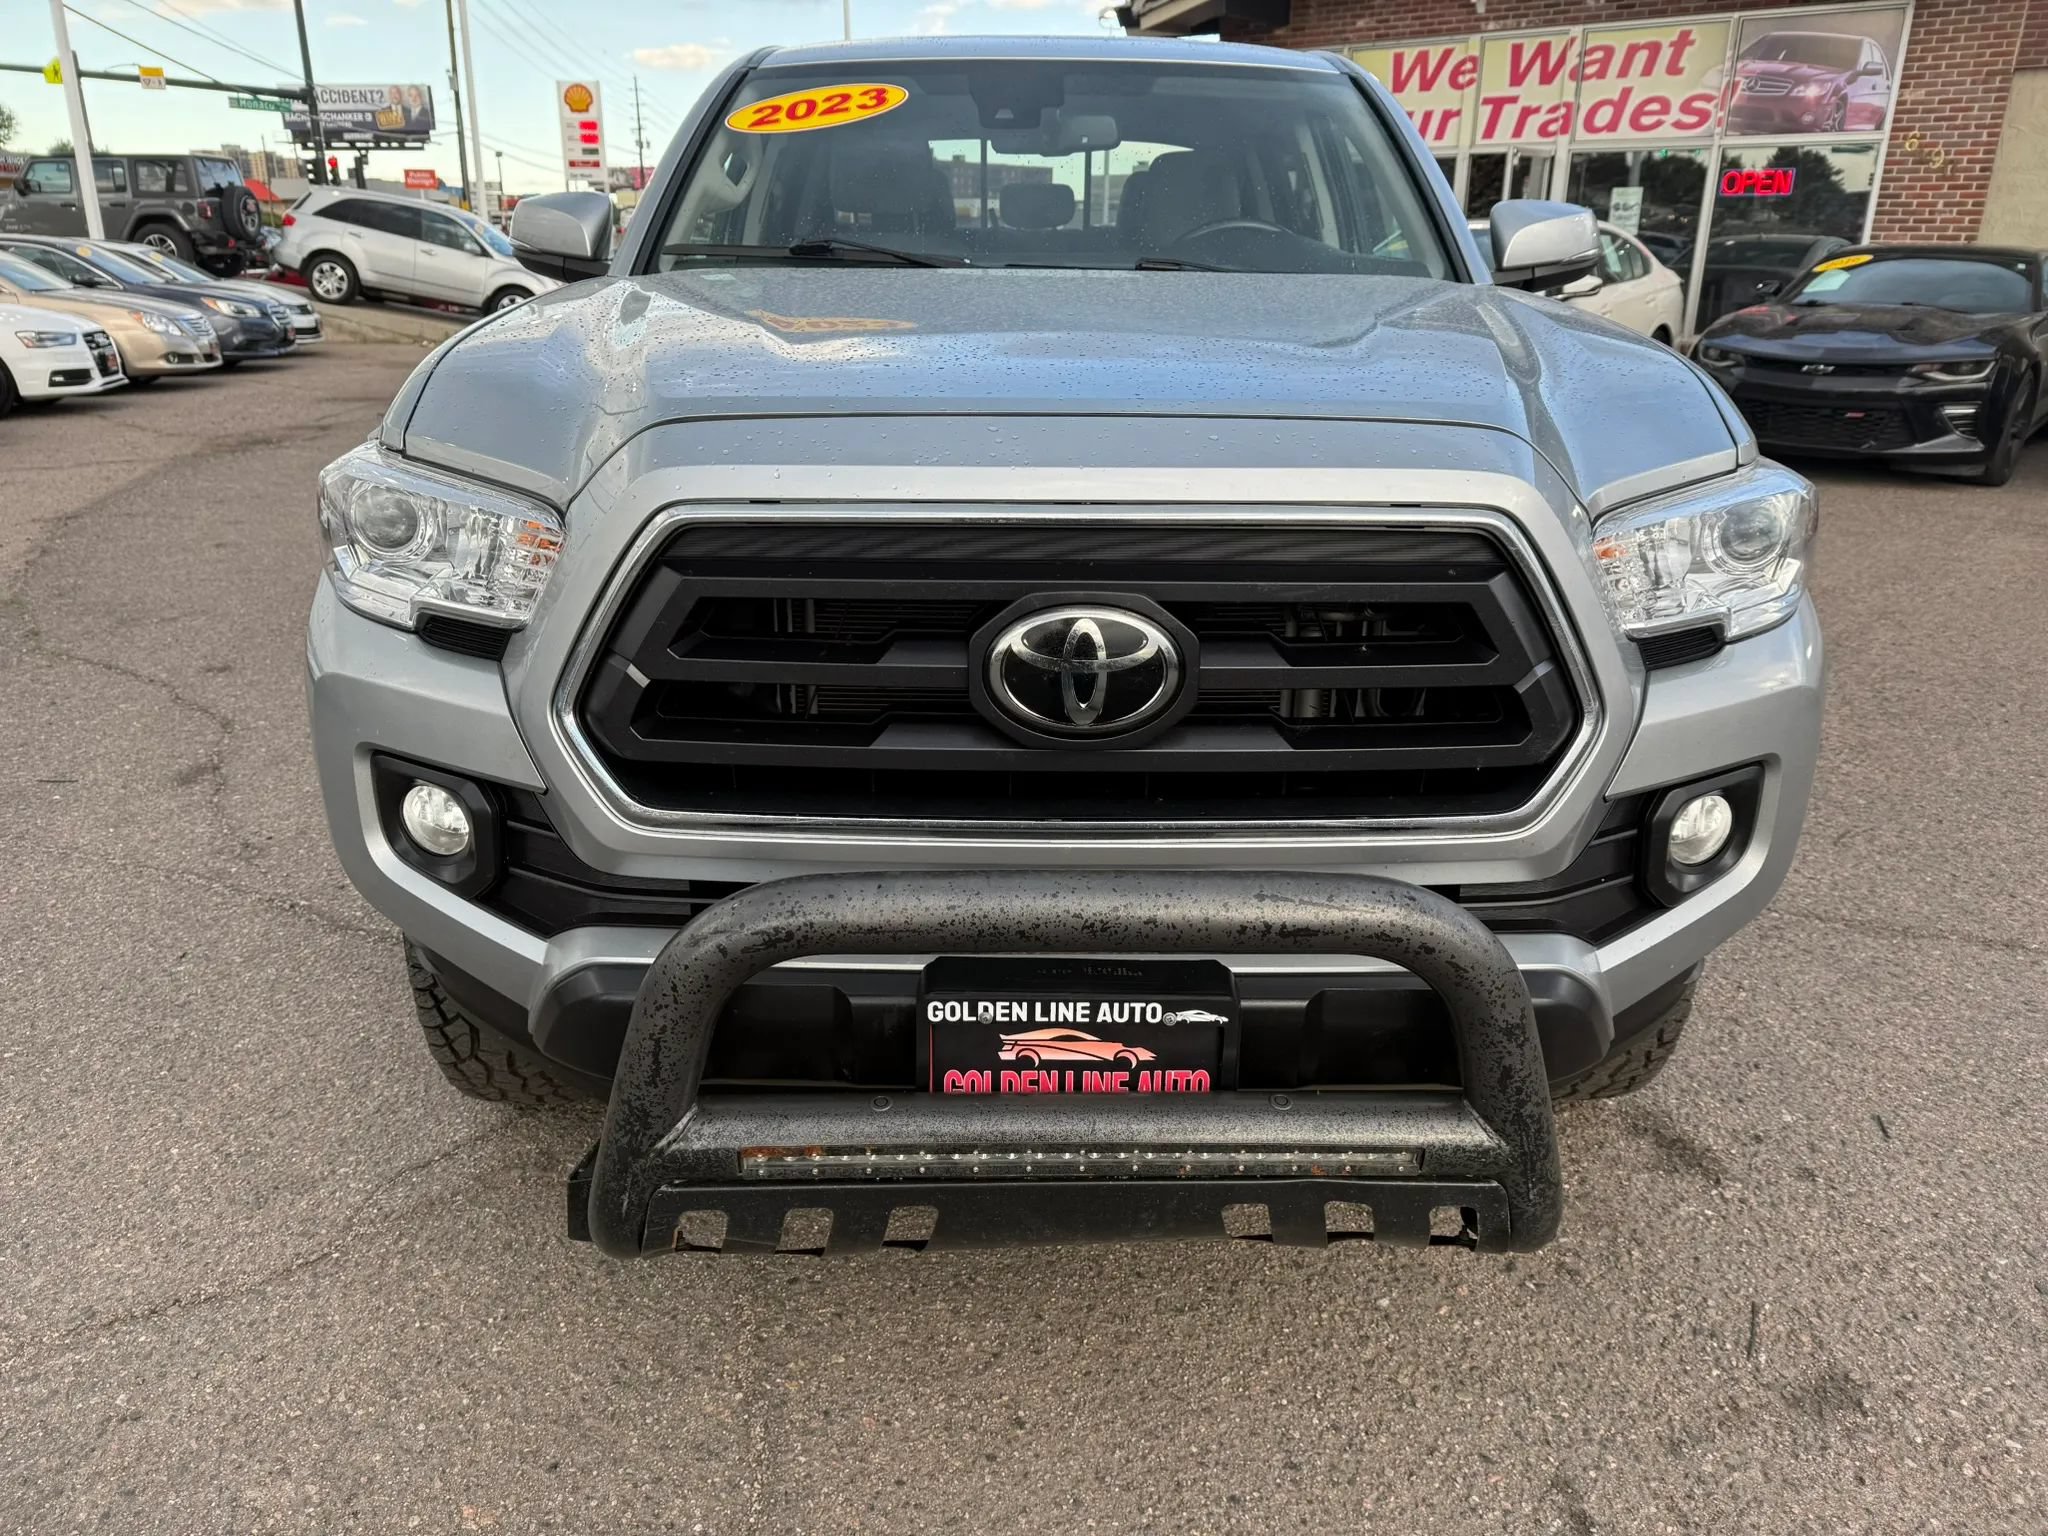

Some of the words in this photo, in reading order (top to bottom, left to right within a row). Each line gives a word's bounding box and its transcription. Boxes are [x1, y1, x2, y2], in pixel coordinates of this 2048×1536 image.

[1392, 47, 1480, 94] We
[1507, 29, 1696, 88] Want
[748, 87, 890, 128] 2023
[1480, 79, 1742, 141] Trades!
[1723, 169, 1794, 195] OPEN
[927, 1001, 1028, 1022] GOLDEN
[1035, 1001, 1090, 1022] LINE
[1096, 1002, 1163, 1023] AUTO
[944, 1069, 1058, 1094] GOLDEN
[1137, 1069, 1210, 1094] AUTO
